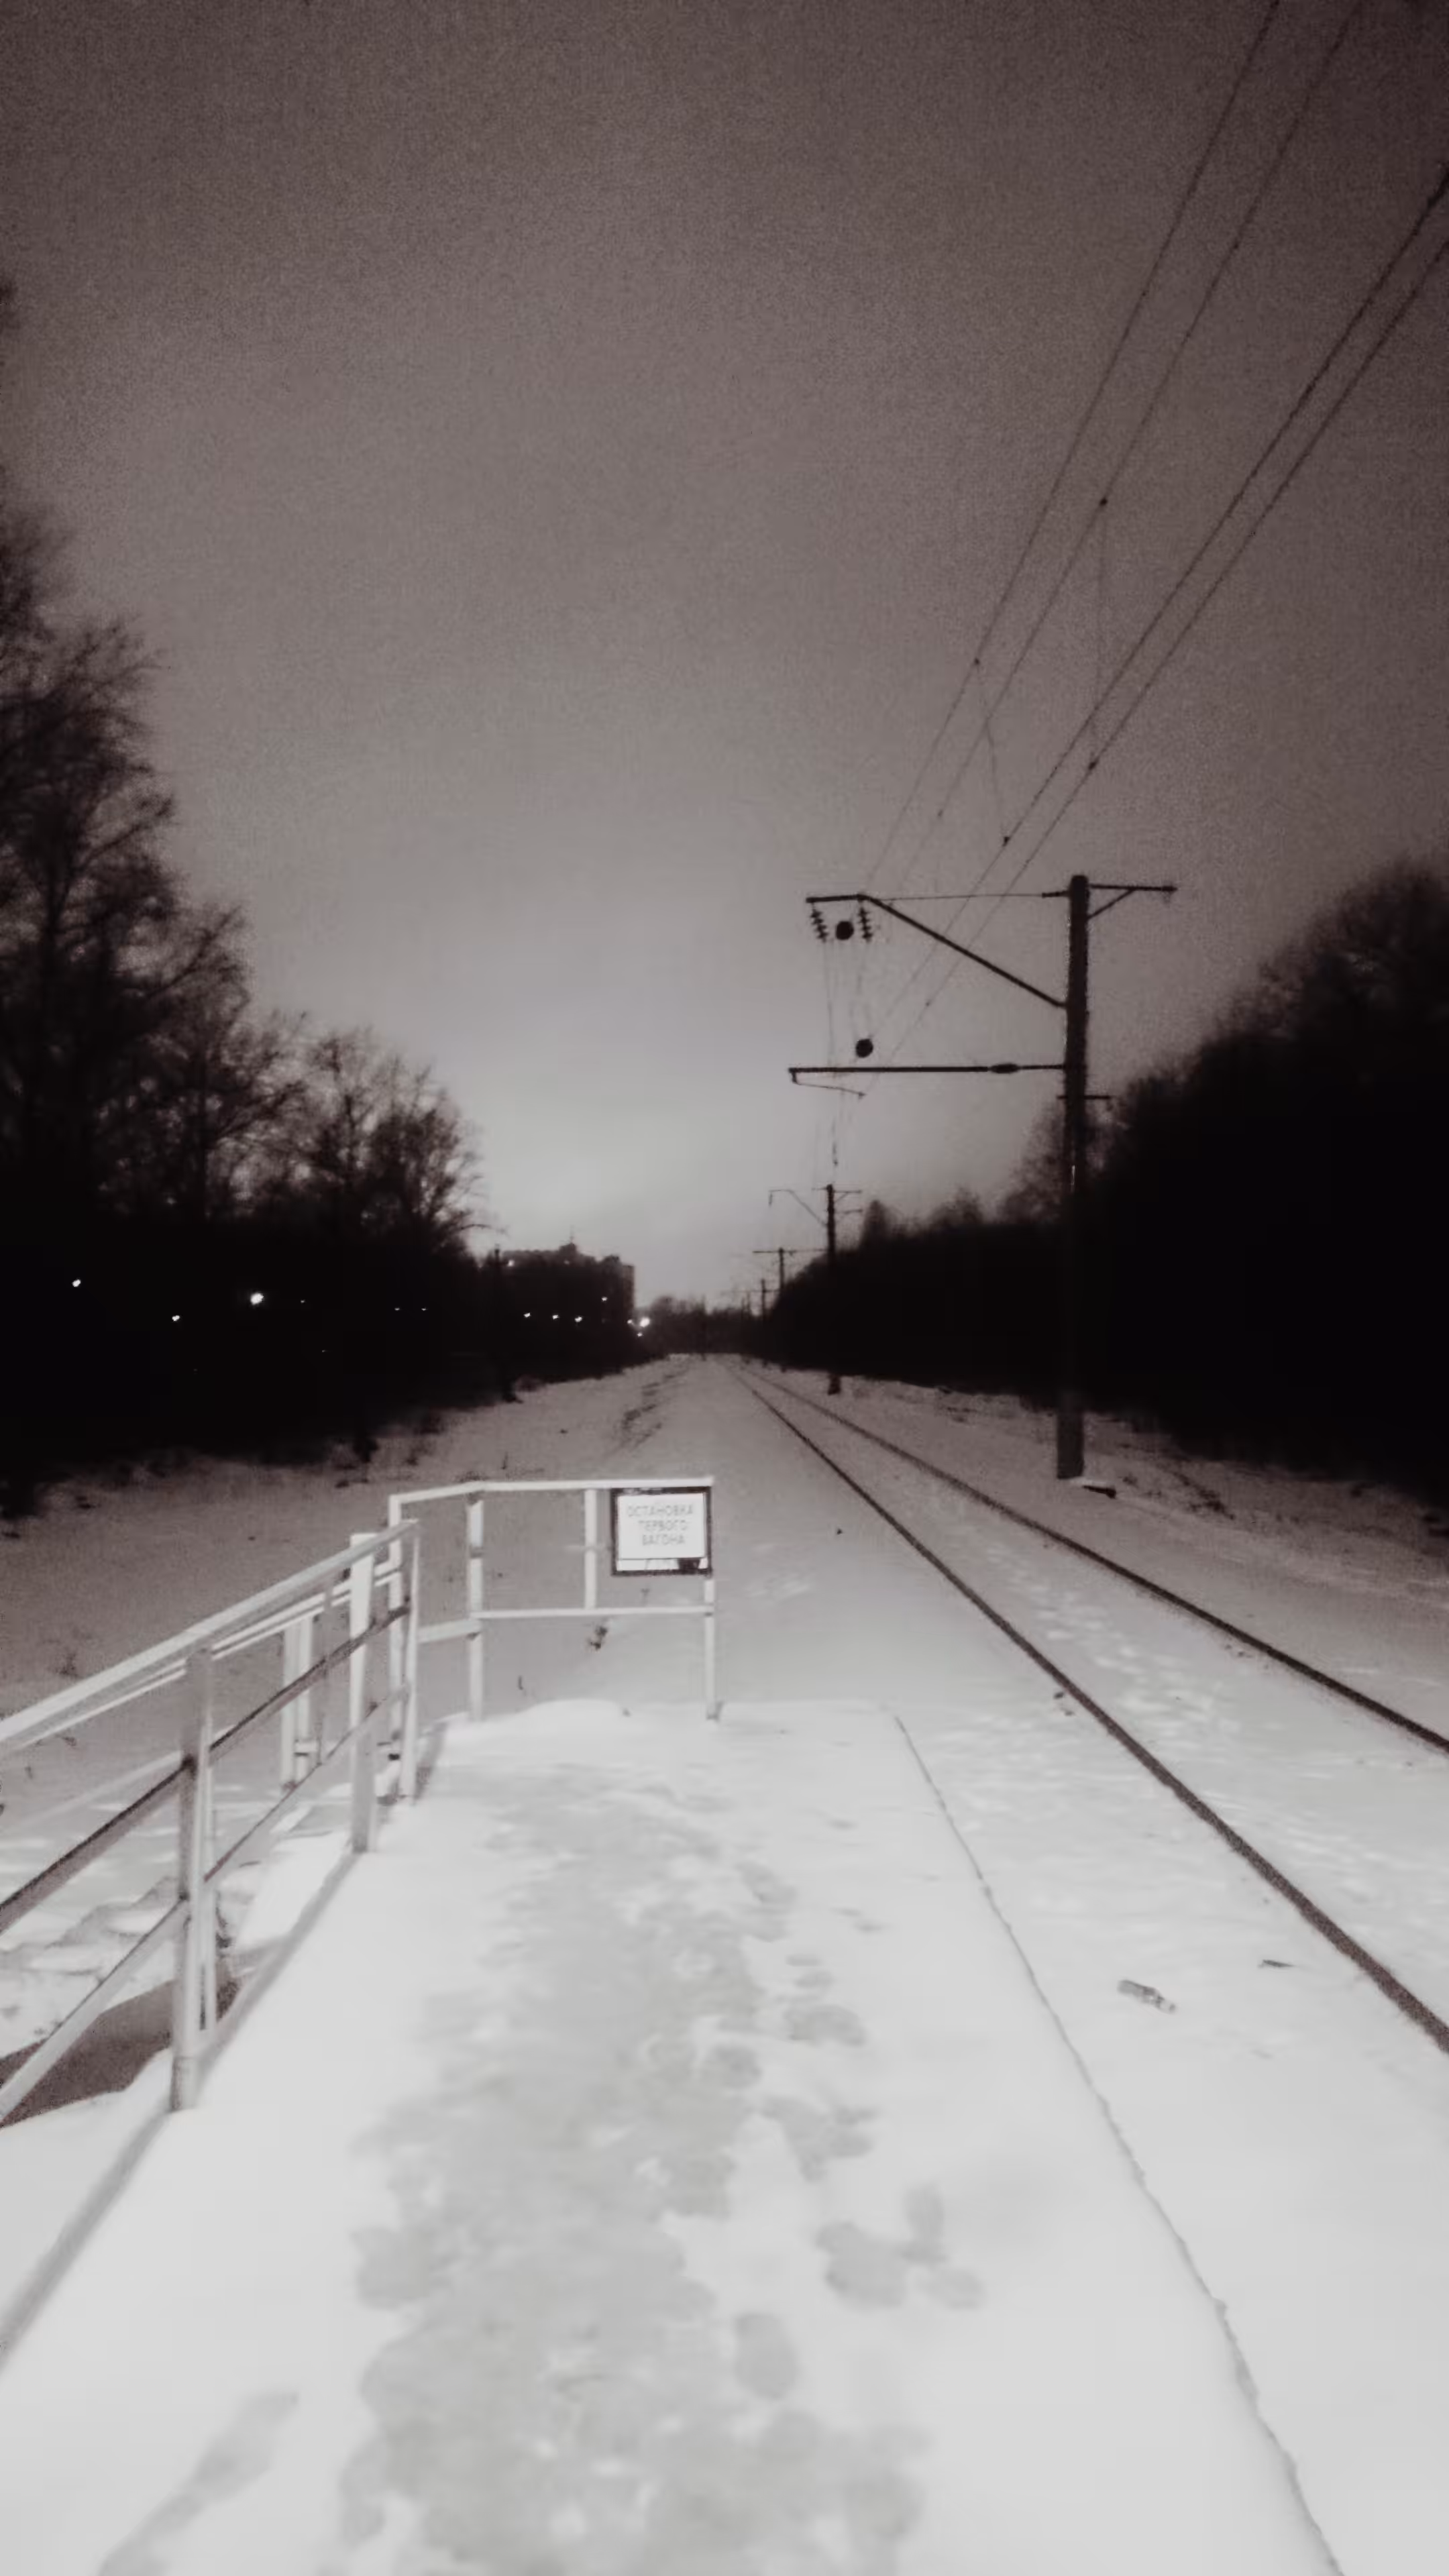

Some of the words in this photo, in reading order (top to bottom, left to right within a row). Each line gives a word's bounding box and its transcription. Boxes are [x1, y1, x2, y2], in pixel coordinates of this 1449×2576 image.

[627, 1505, 693, 1517] ОСТАНОВКА
[638, 1519, 688, 1532] ПЕРВОГО
[642, 1534, 686, 1546] ВАГОНА
